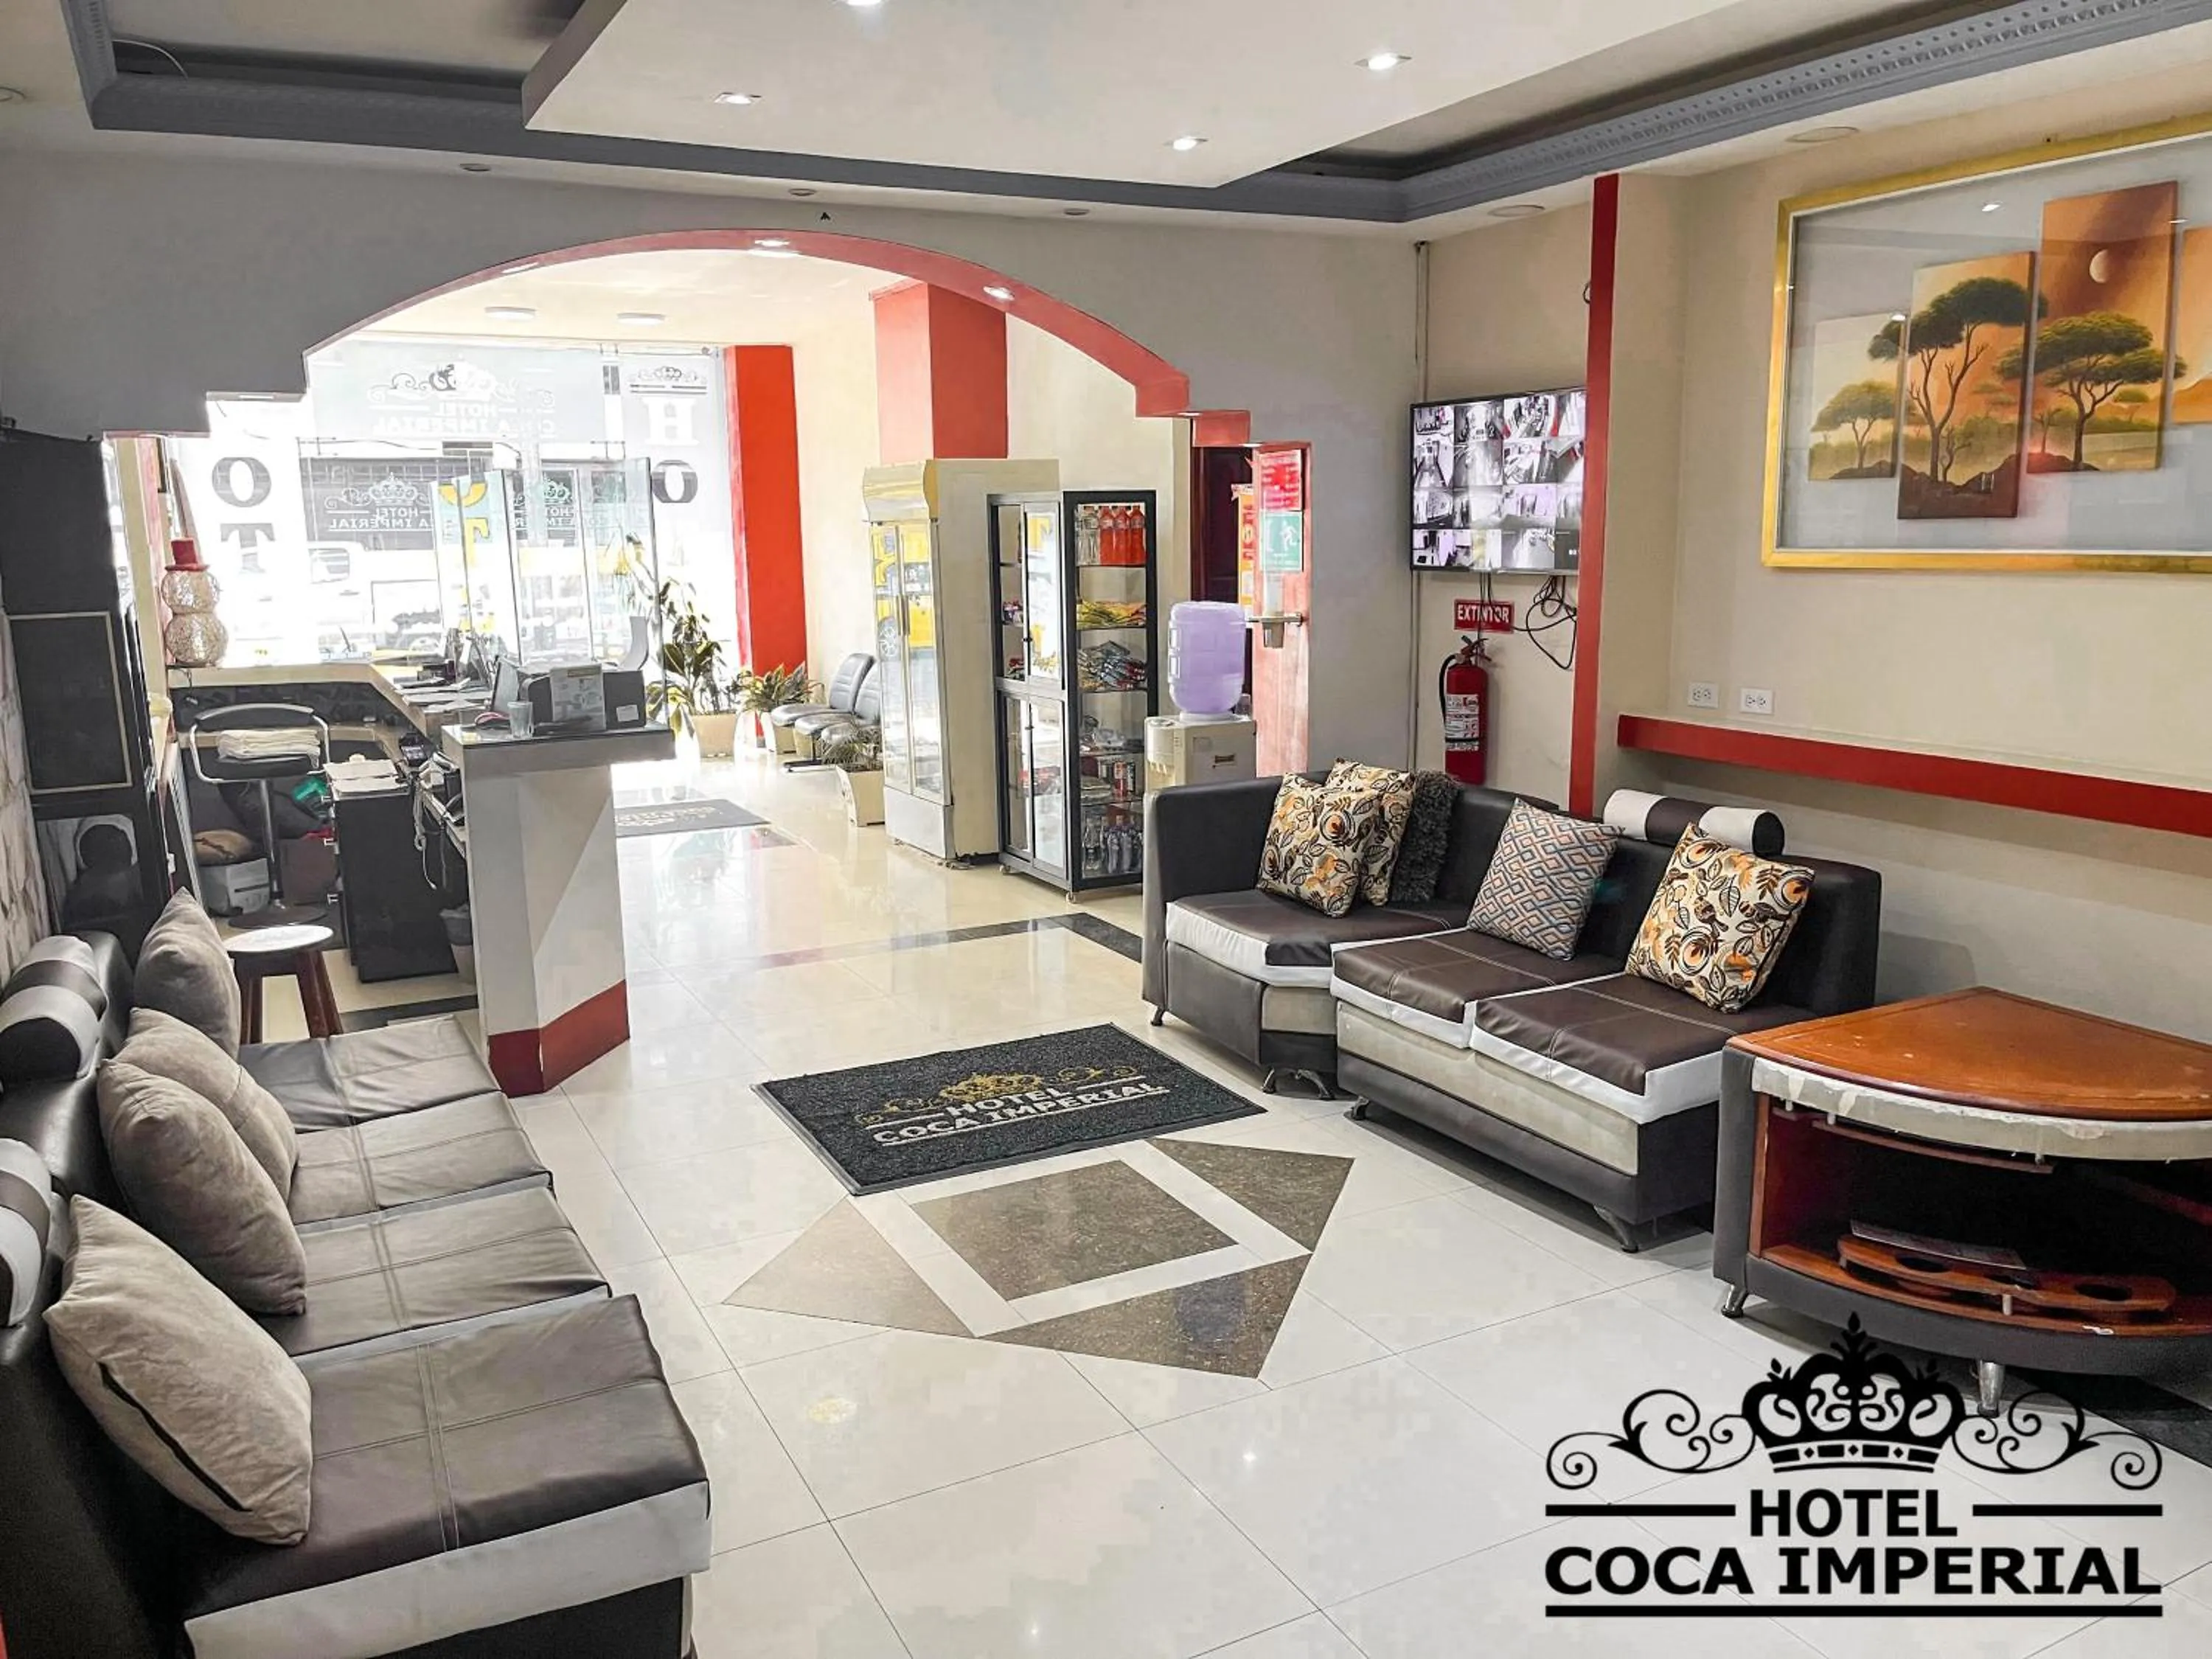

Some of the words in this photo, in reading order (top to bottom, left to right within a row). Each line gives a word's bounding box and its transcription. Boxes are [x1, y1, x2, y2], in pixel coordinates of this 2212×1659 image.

[1458, 605, 1509, 623] EXTINTOR
[874, 1117, 981, 1144] COCA
[990, 1082, 1166, 1122] IMPERIAL
[947, 1087, 1072, 1116] HOTEL
